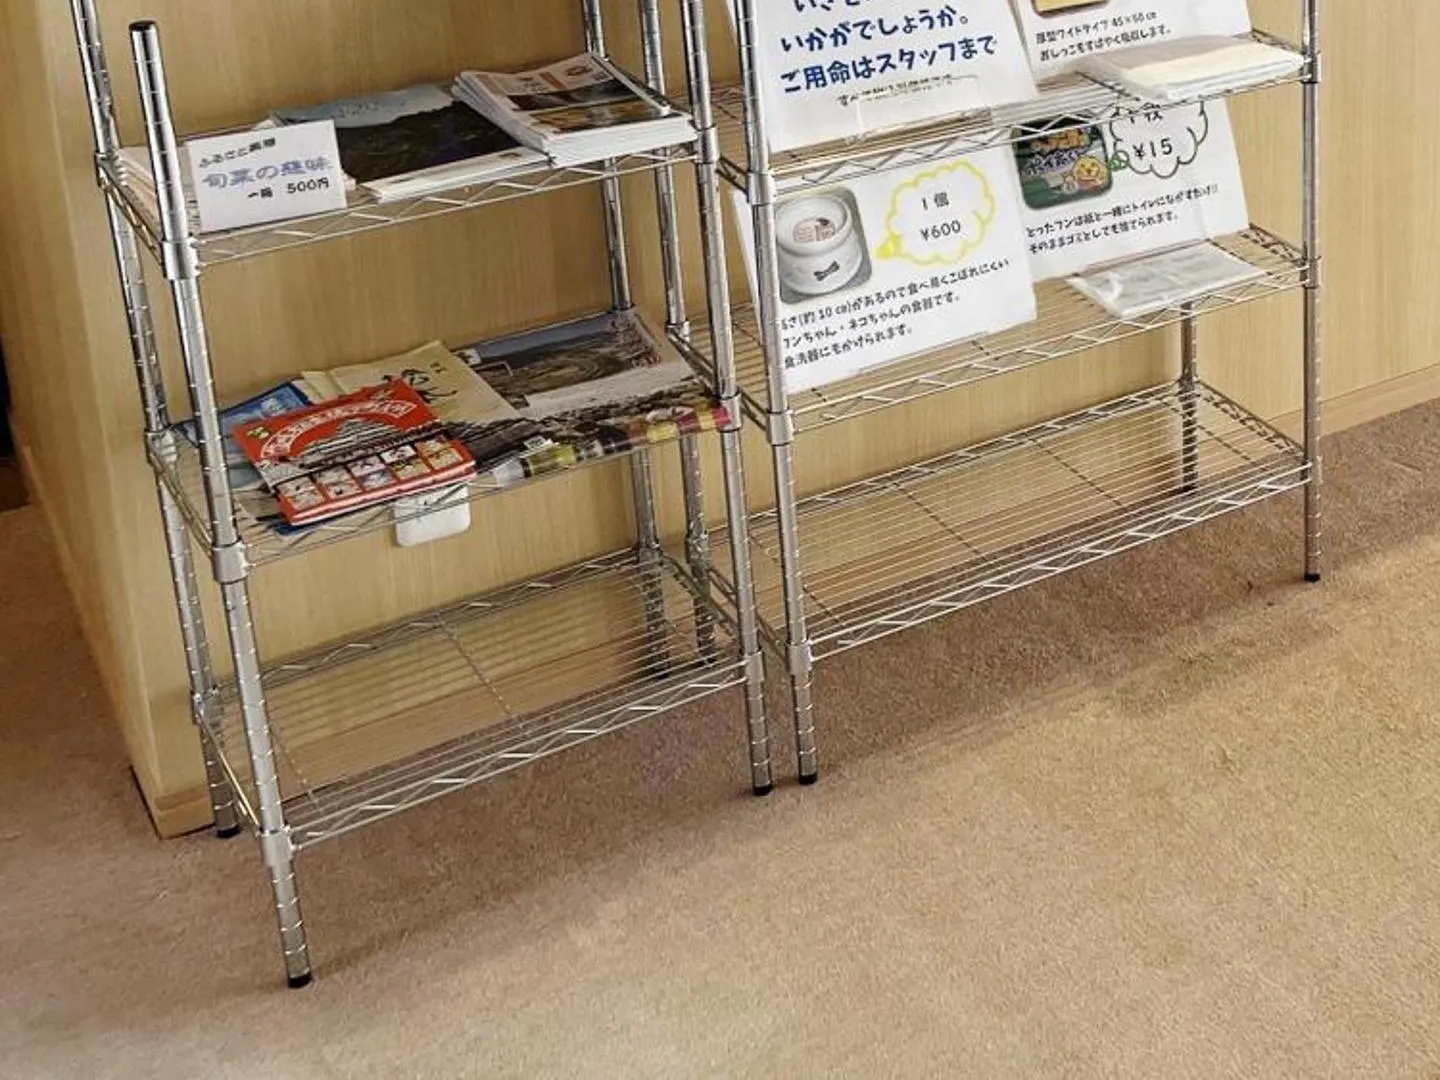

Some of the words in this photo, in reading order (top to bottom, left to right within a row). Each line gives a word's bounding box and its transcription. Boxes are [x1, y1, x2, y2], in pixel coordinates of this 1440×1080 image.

[780, 5, 969, 52] いかがでしょうか。
[780, 35, 998, 93] ご用命はスタッフまで
[1132, 137, 1174, 160] ¥15
[287, 177, 330, 195] 500円
[919, 220, 962, 242] ¥600
